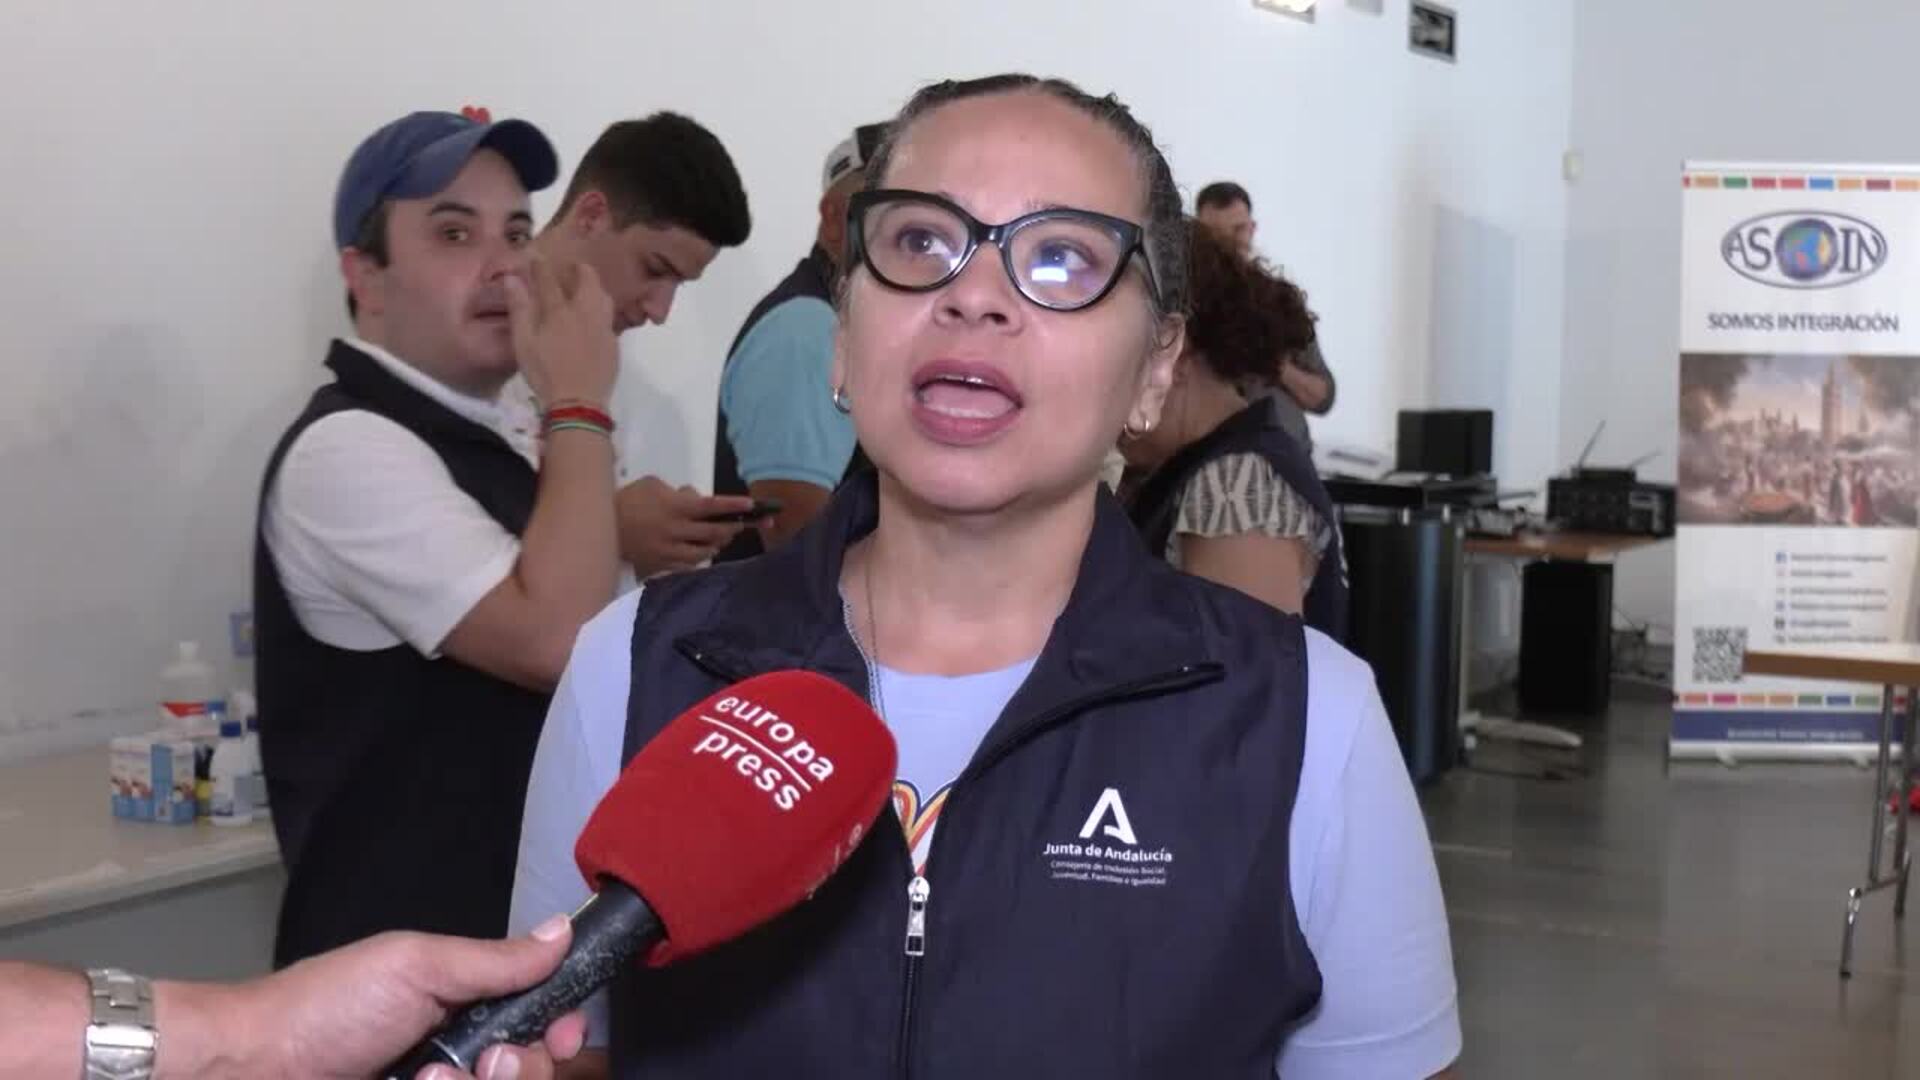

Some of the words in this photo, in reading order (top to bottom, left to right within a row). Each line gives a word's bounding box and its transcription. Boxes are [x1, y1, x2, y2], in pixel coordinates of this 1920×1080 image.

[1723, 217, 1885, 281] ASOIN
[1707, 312, 1775, 332] SOMOS
[1777, 310, 1899, 333] INTEGRACIÓN
[693, 731, 801, 811] press
[714, 695, 835, 783] europa
[1043, 842, 1083, 856] Junta
[1085, 843, 1102, 858] de
[1104, 846, 1173, 862] Andalucía
